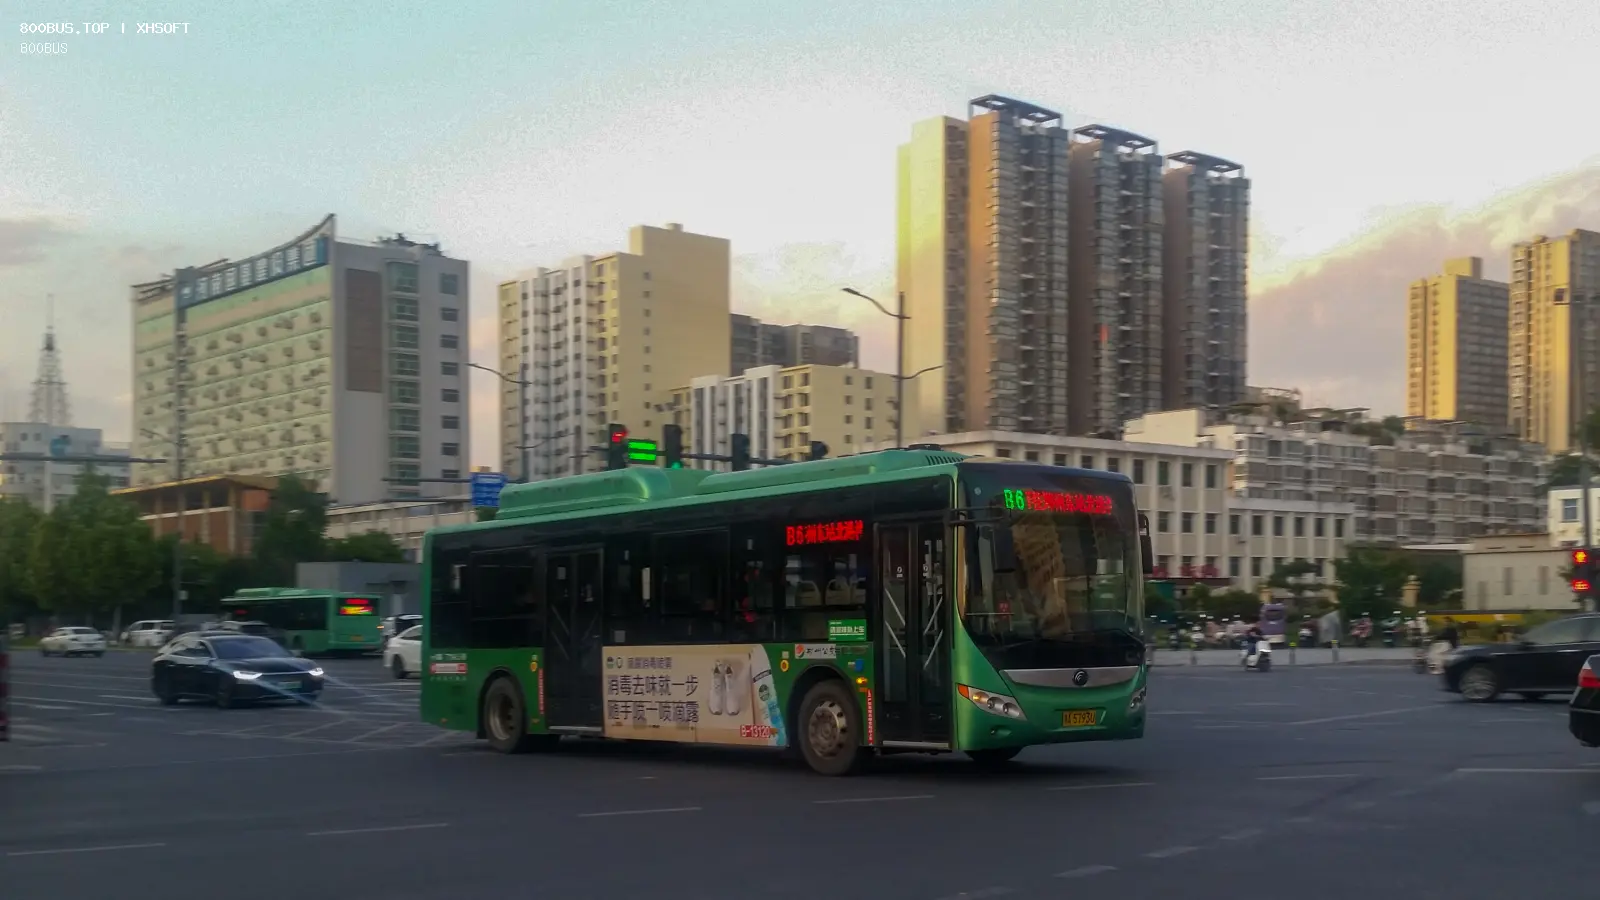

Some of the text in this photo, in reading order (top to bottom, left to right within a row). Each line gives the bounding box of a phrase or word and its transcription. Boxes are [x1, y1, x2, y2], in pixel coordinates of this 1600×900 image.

[1003, 489, 1025, 510] B6
[607, 674, 699, 697] 消毒去味就一步
